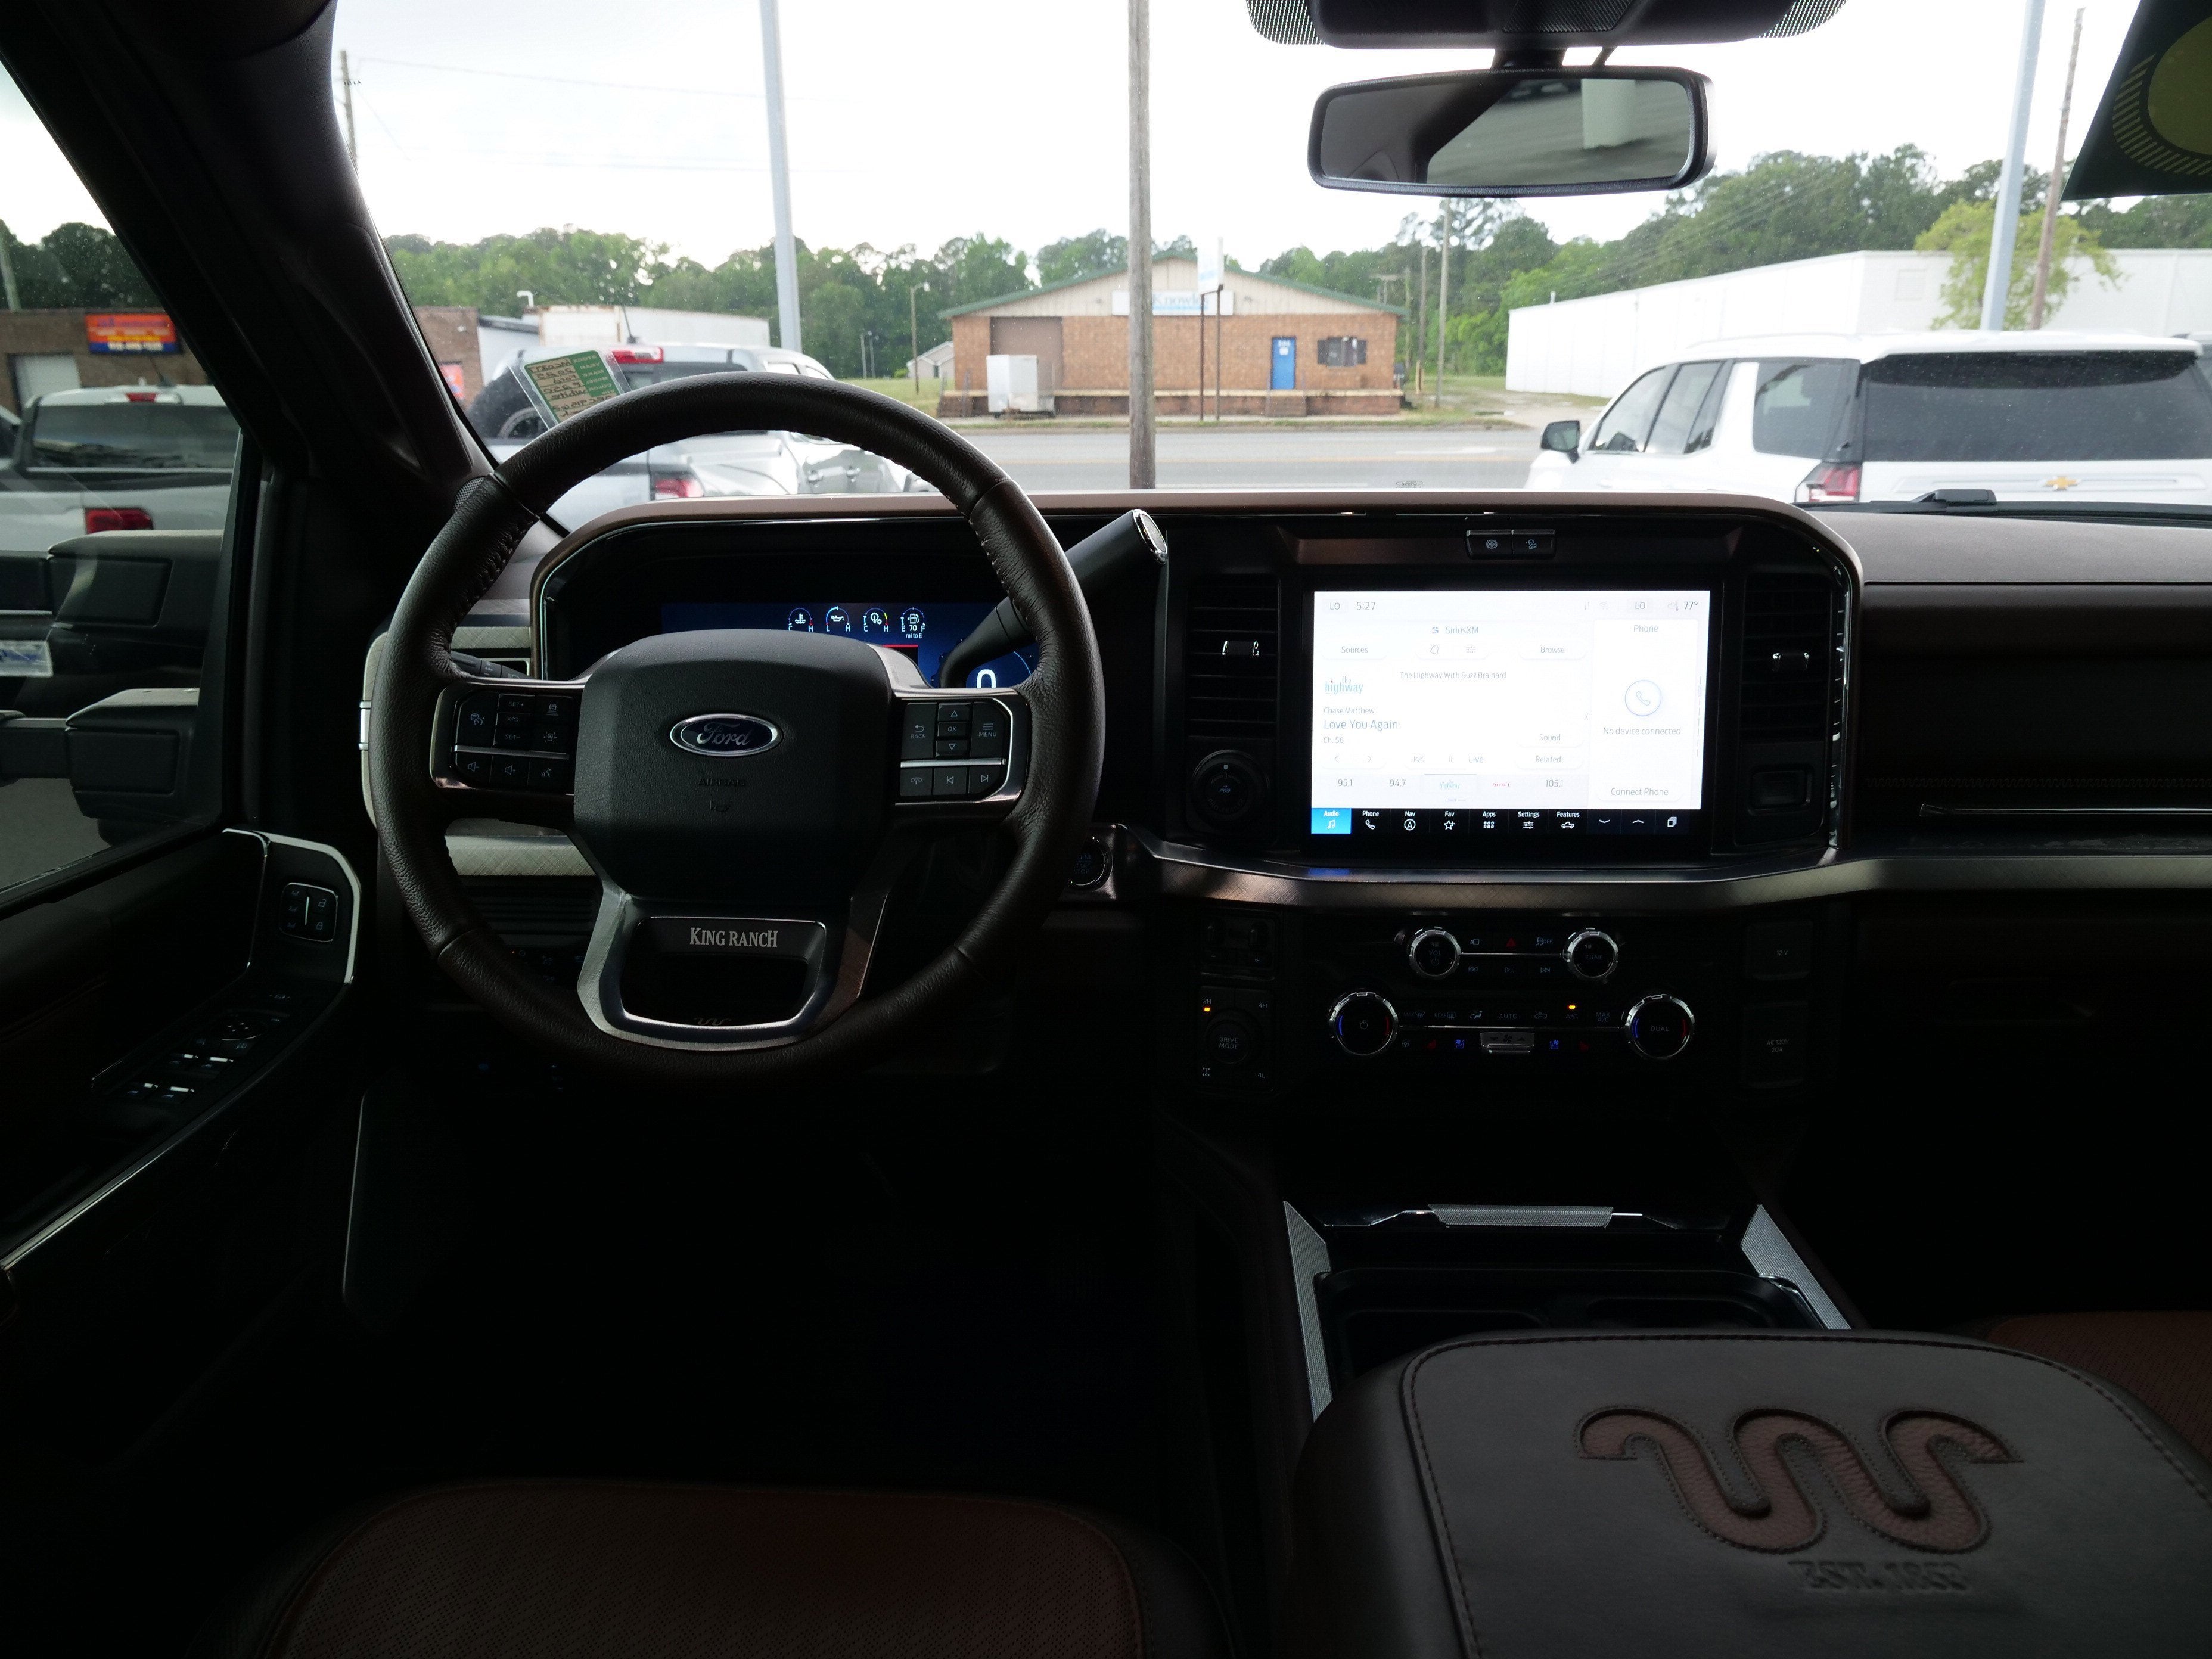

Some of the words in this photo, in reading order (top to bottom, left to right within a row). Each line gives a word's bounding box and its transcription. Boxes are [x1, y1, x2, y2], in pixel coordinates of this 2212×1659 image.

[1329, 602, 1340, 610] LO
[1356, 602, 1376, 611] 5:27
[1635, 602, 1646, 610] LO
[1683, 601, 1698, 610] 77°
[1445, 626, 1479, 635] SiriusXM
[1633, 625, 1658, 633] Phone
[1341, 645, 1369, 654] Sources
[1413, 672, 1442, 681] Highway
[1325, 681, 1363, 695] highway
[1324, 719, 1347, 729] Love
[1349, 719, 1368, 729] You
[1370, 719, 1399, 731] Again
[696, 722, 751, 747] Ford
[1618, 726, 1640, 735] device
[1641, 726, 1682, 735] connected
[698, 778, 747, 787] AIRBAG
[1545, 779, 1564, 788] 105.1
[1611, 788, 1642, 796] Connect
[1644, 788, 1669, 796] Phone
[689, 927, 725, 946] KING
[732, 930, 778, 948] RANCH
[1788, 1560, 1884, 1590] EST.
